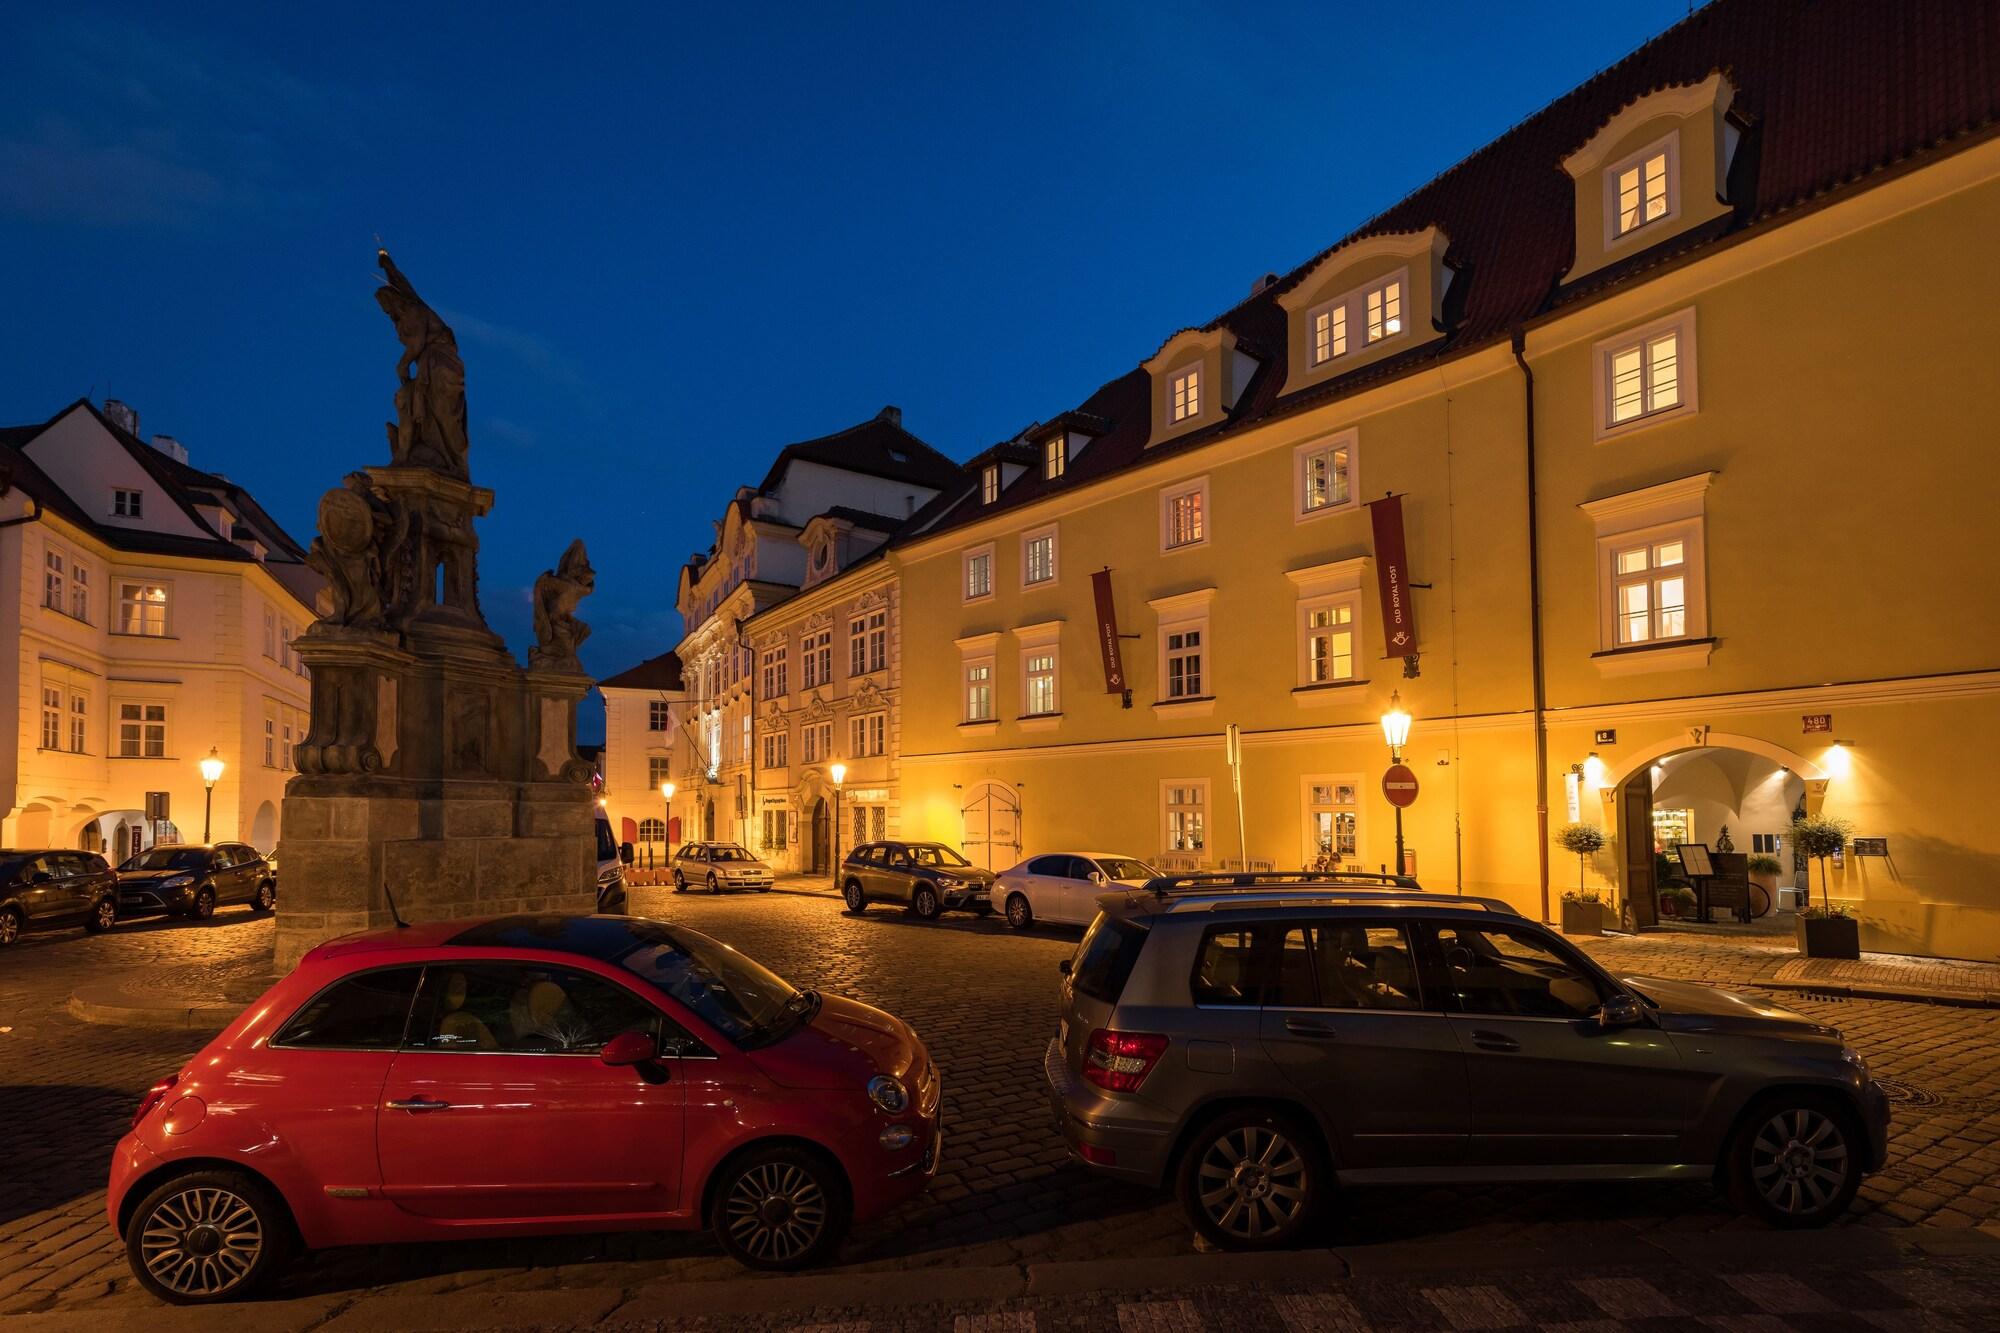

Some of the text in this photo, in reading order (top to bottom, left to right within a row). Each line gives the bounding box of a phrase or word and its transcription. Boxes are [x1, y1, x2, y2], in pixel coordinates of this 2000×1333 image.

[1389, 565, 1397, 584] POST
[1391, 585, 1400, 608] ROYAL
[1807, 716, 1826, 725] 480
